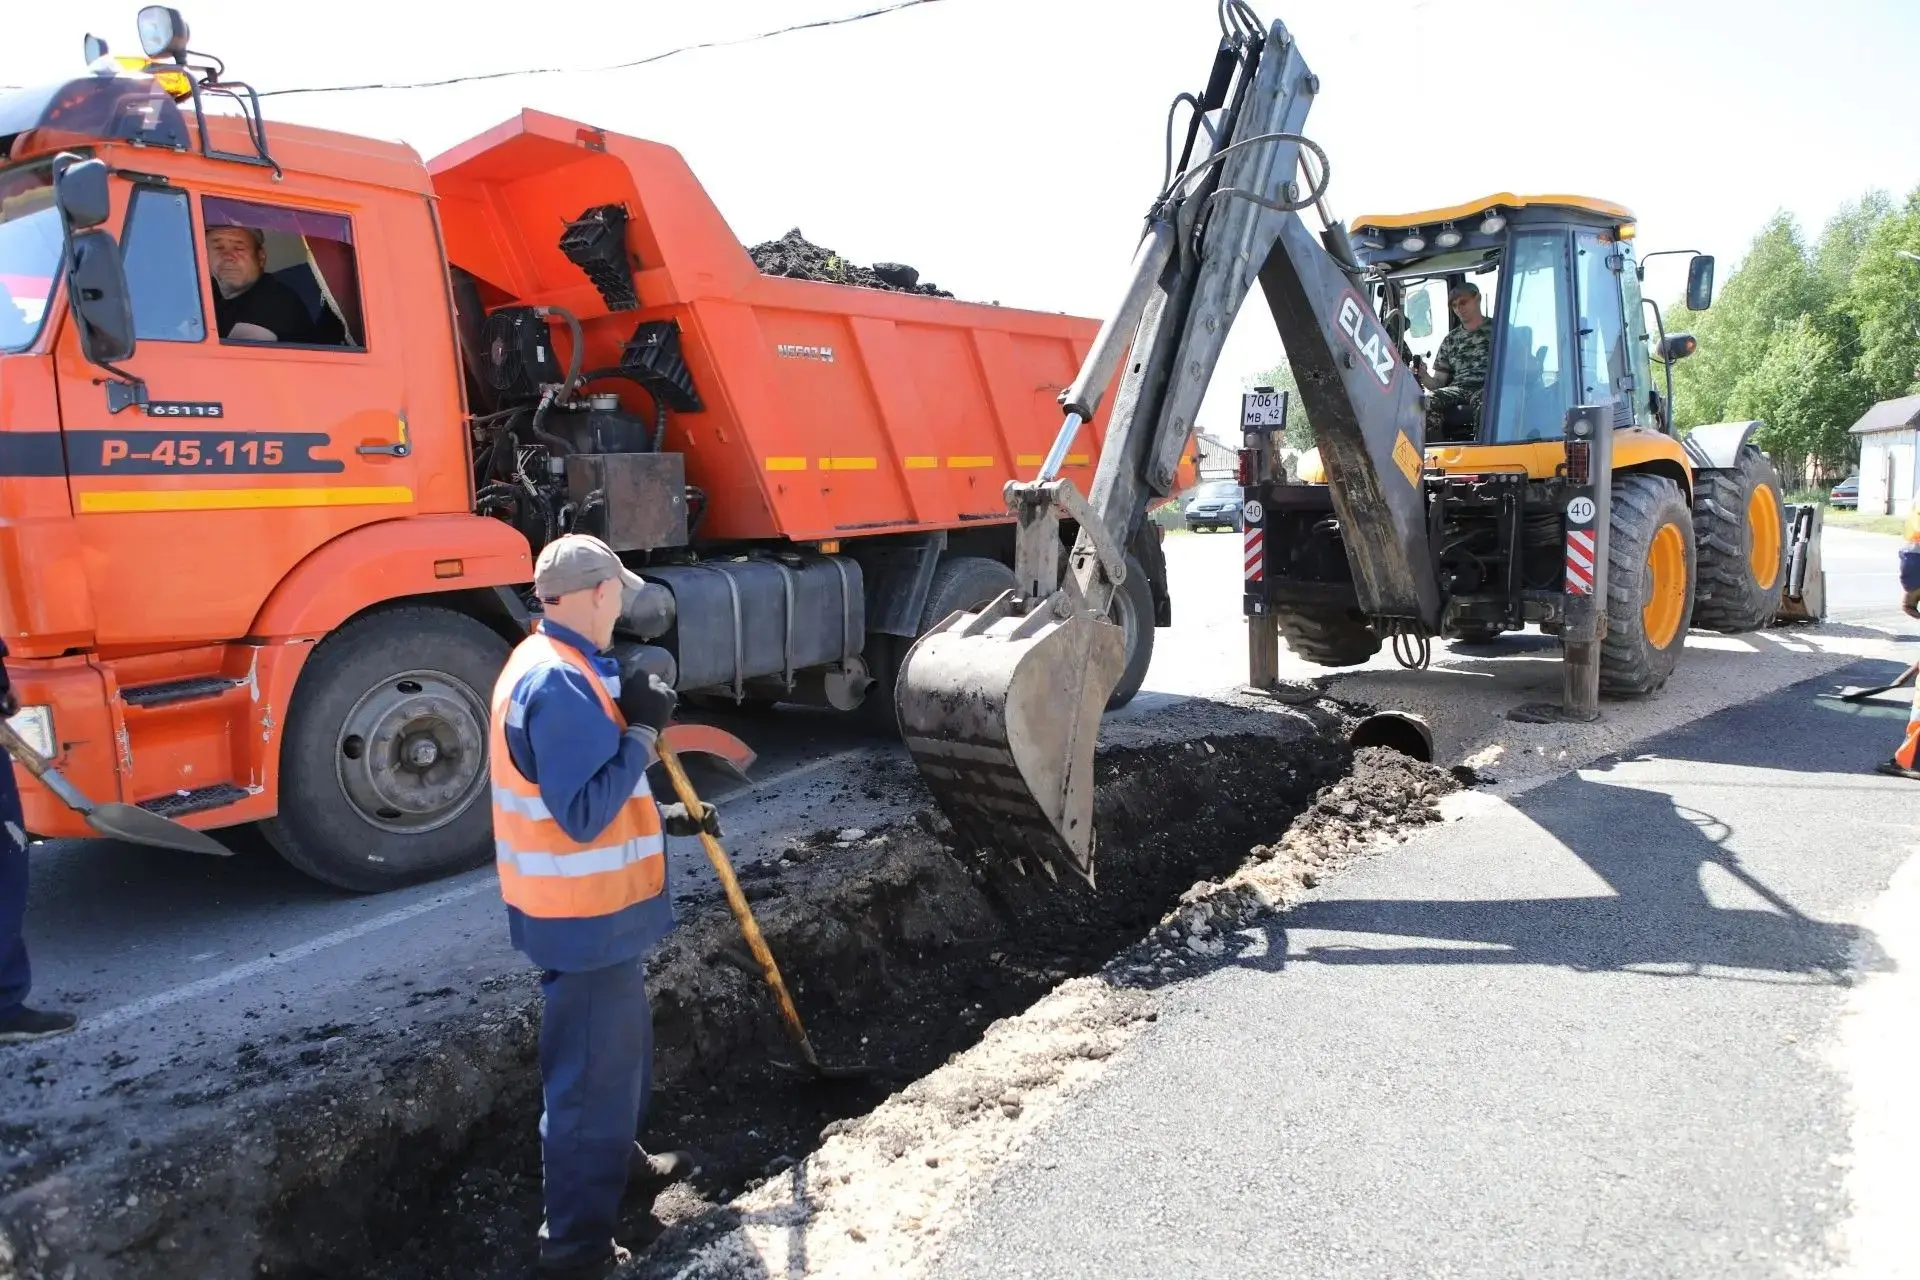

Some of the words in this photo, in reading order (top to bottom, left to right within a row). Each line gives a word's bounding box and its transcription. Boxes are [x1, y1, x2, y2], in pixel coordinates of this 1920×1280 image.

[1338, 296, 1395, 385] ELAZ
[1251, 394, 1279, 407] 7061
[154, 405, 220, 416] 65115
[1246, 412, 1262, 423] MB
[1268, 409, 1280, 419] 42
[101, 440, 284, 466] P-45.115
[1246, 505, 1261, 517] 40
[1570, 503, 1592, 517] 40
